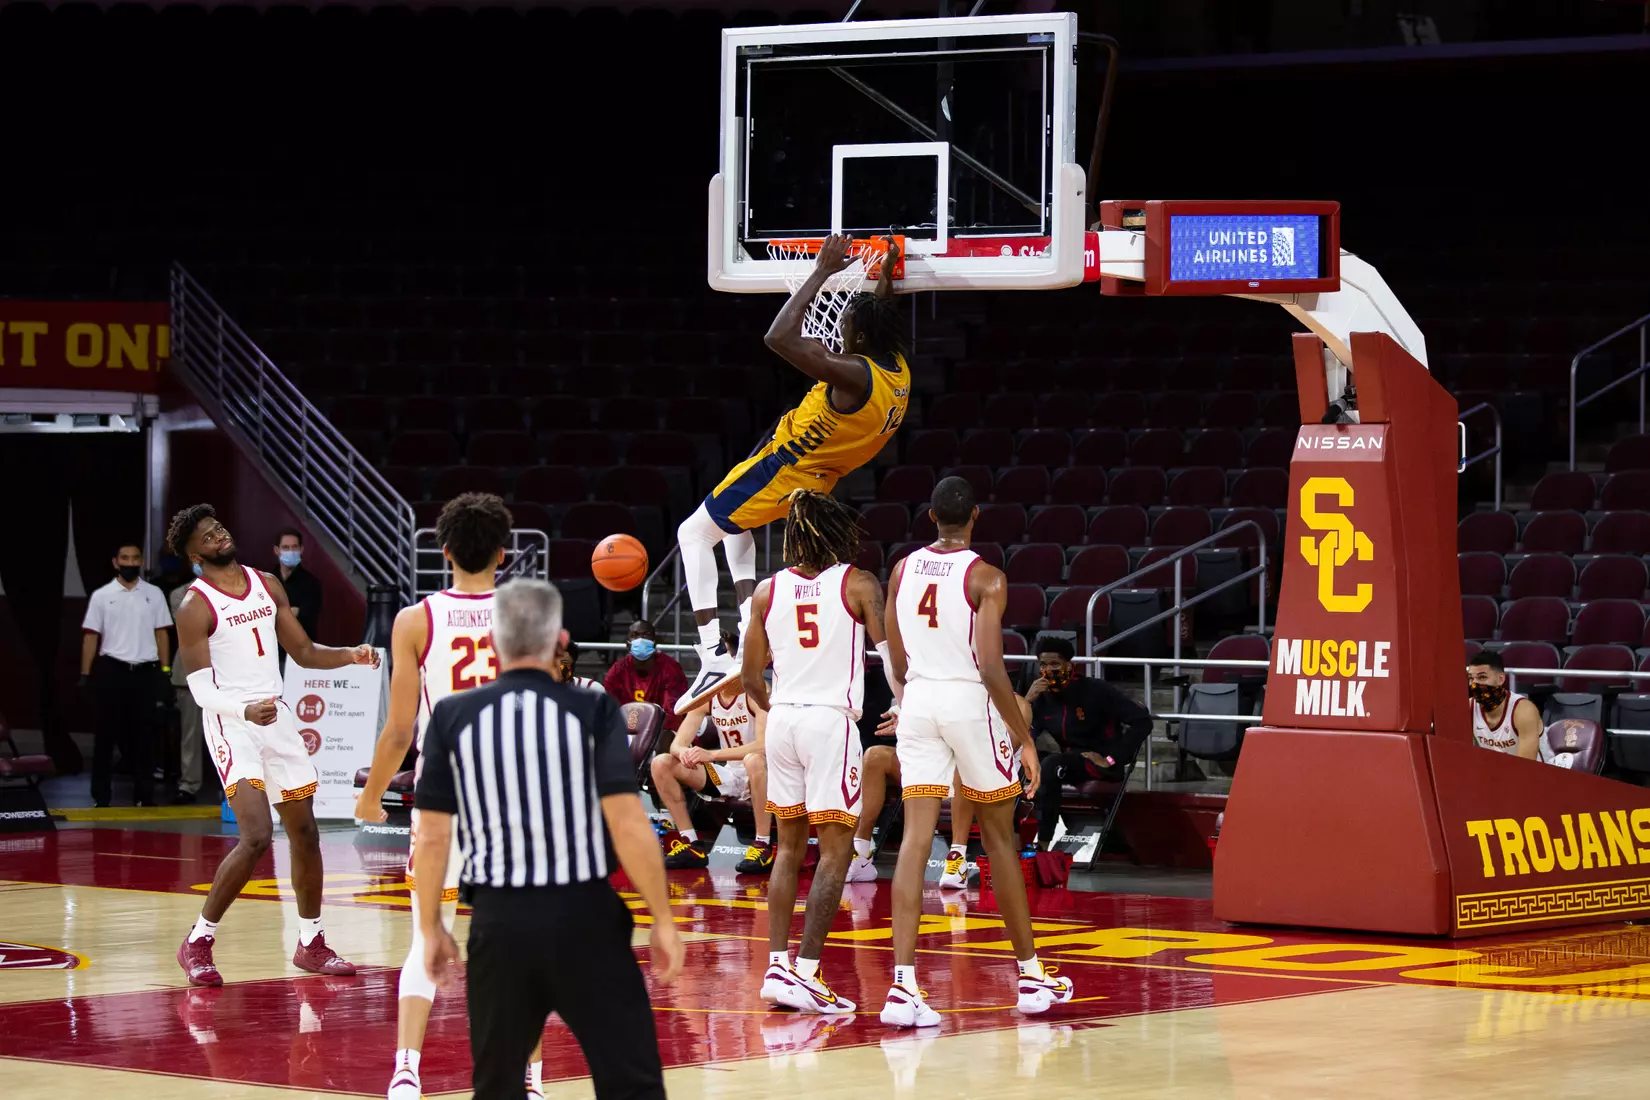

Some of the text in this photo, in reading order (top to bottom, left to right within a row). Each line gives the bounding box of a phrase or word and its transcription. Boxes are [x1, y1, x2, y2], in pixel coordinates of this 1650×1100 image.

[1209, 231, 1268, 245] UNITED
[1193, 249, 1268, 264] AIRLINES
[65, 322, 170, 373] ON!
[1297, 436, 1383, 449] NISSAN
[1300, 476, 1374, 613] SC
[794, 581, 822, 600] WHITE
[917, 582, 939, 629] 4
[225, 605, 273, 627] TROJANS
[447, 609, 493, 628] AGBONKP
[795, 603, 820, 649] 5
[251, 626, 265, 657] 1
[450, 635, 503, 692] 23
[1276, 638, 1391, 678] MUSCLE
[304, 679, 331, 689] HERE
[333, 679, 349, 689] WE
[329, 702, 343, 710] Stay
[0, 810, 47, 819] POWERADE
[362, 825, 411, 836] POWERADE
[712, 845, 748, 856] POWER
[1466, 808, 1650, 878] TROJANS
